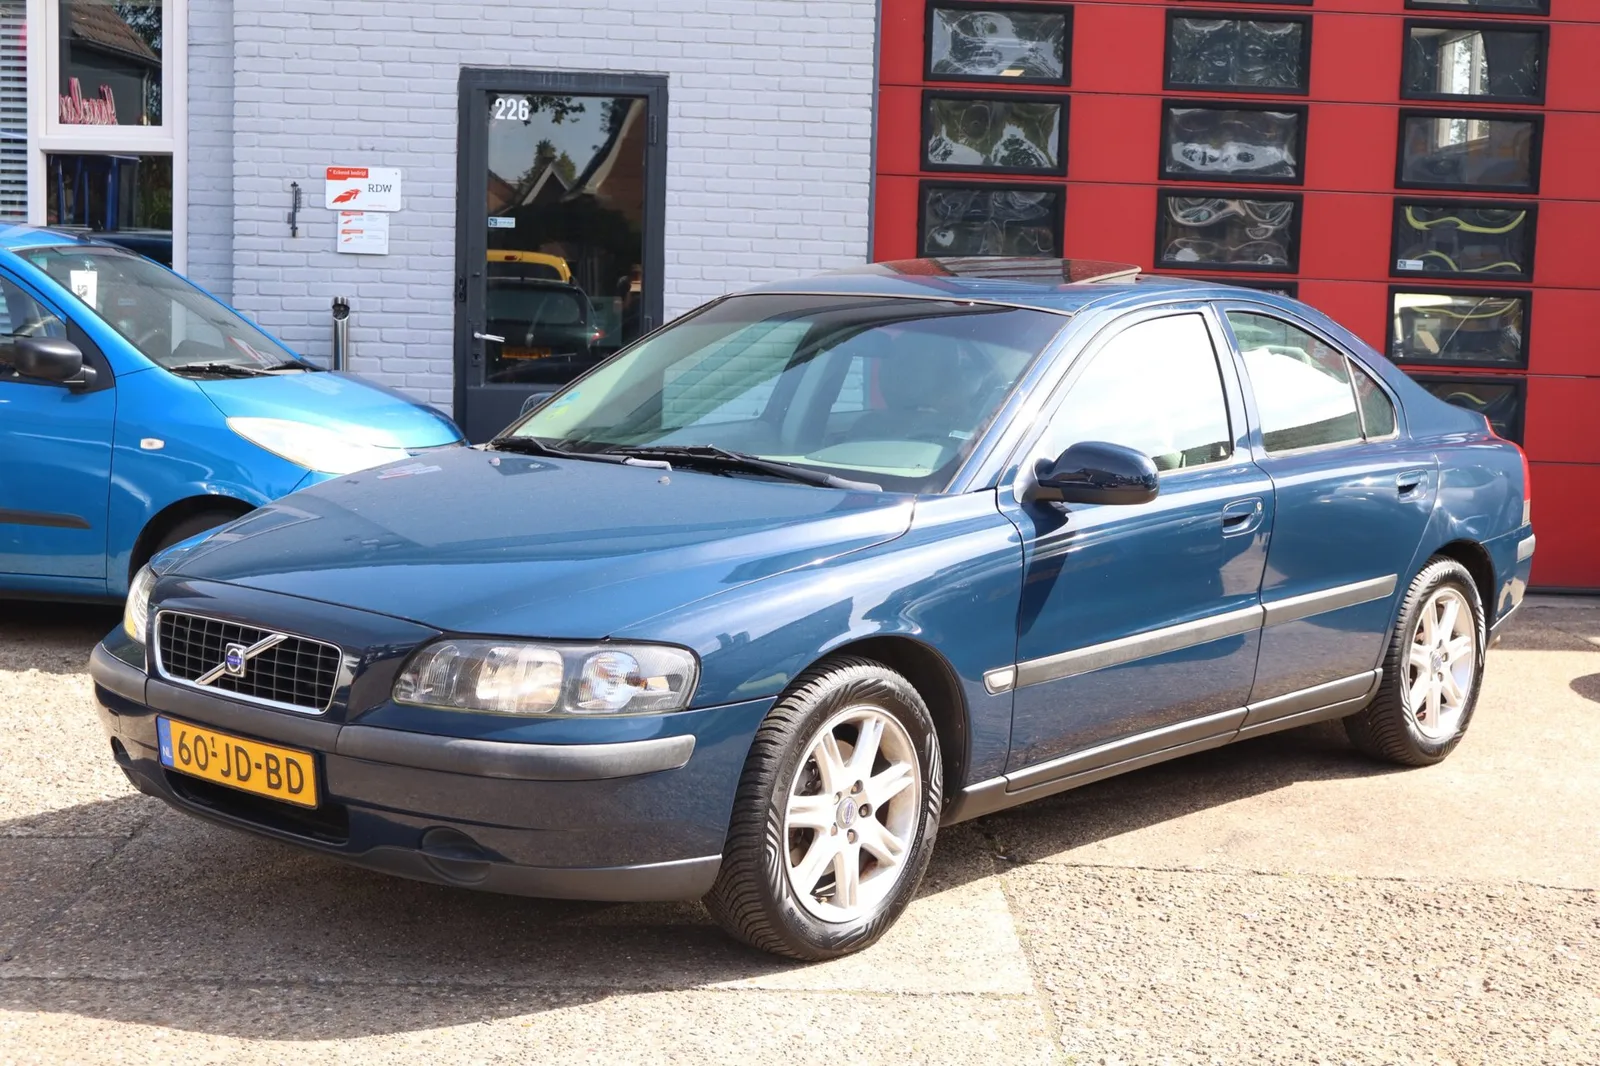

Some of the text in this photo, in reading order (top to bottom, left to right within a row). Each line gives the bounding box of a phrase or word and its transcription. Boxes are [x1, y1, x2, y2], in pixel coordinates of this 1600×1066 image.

[495, 98, 529, 120] 226
[368, 184, 392, 193] RDW
[162, 746, 173, 758] NL
